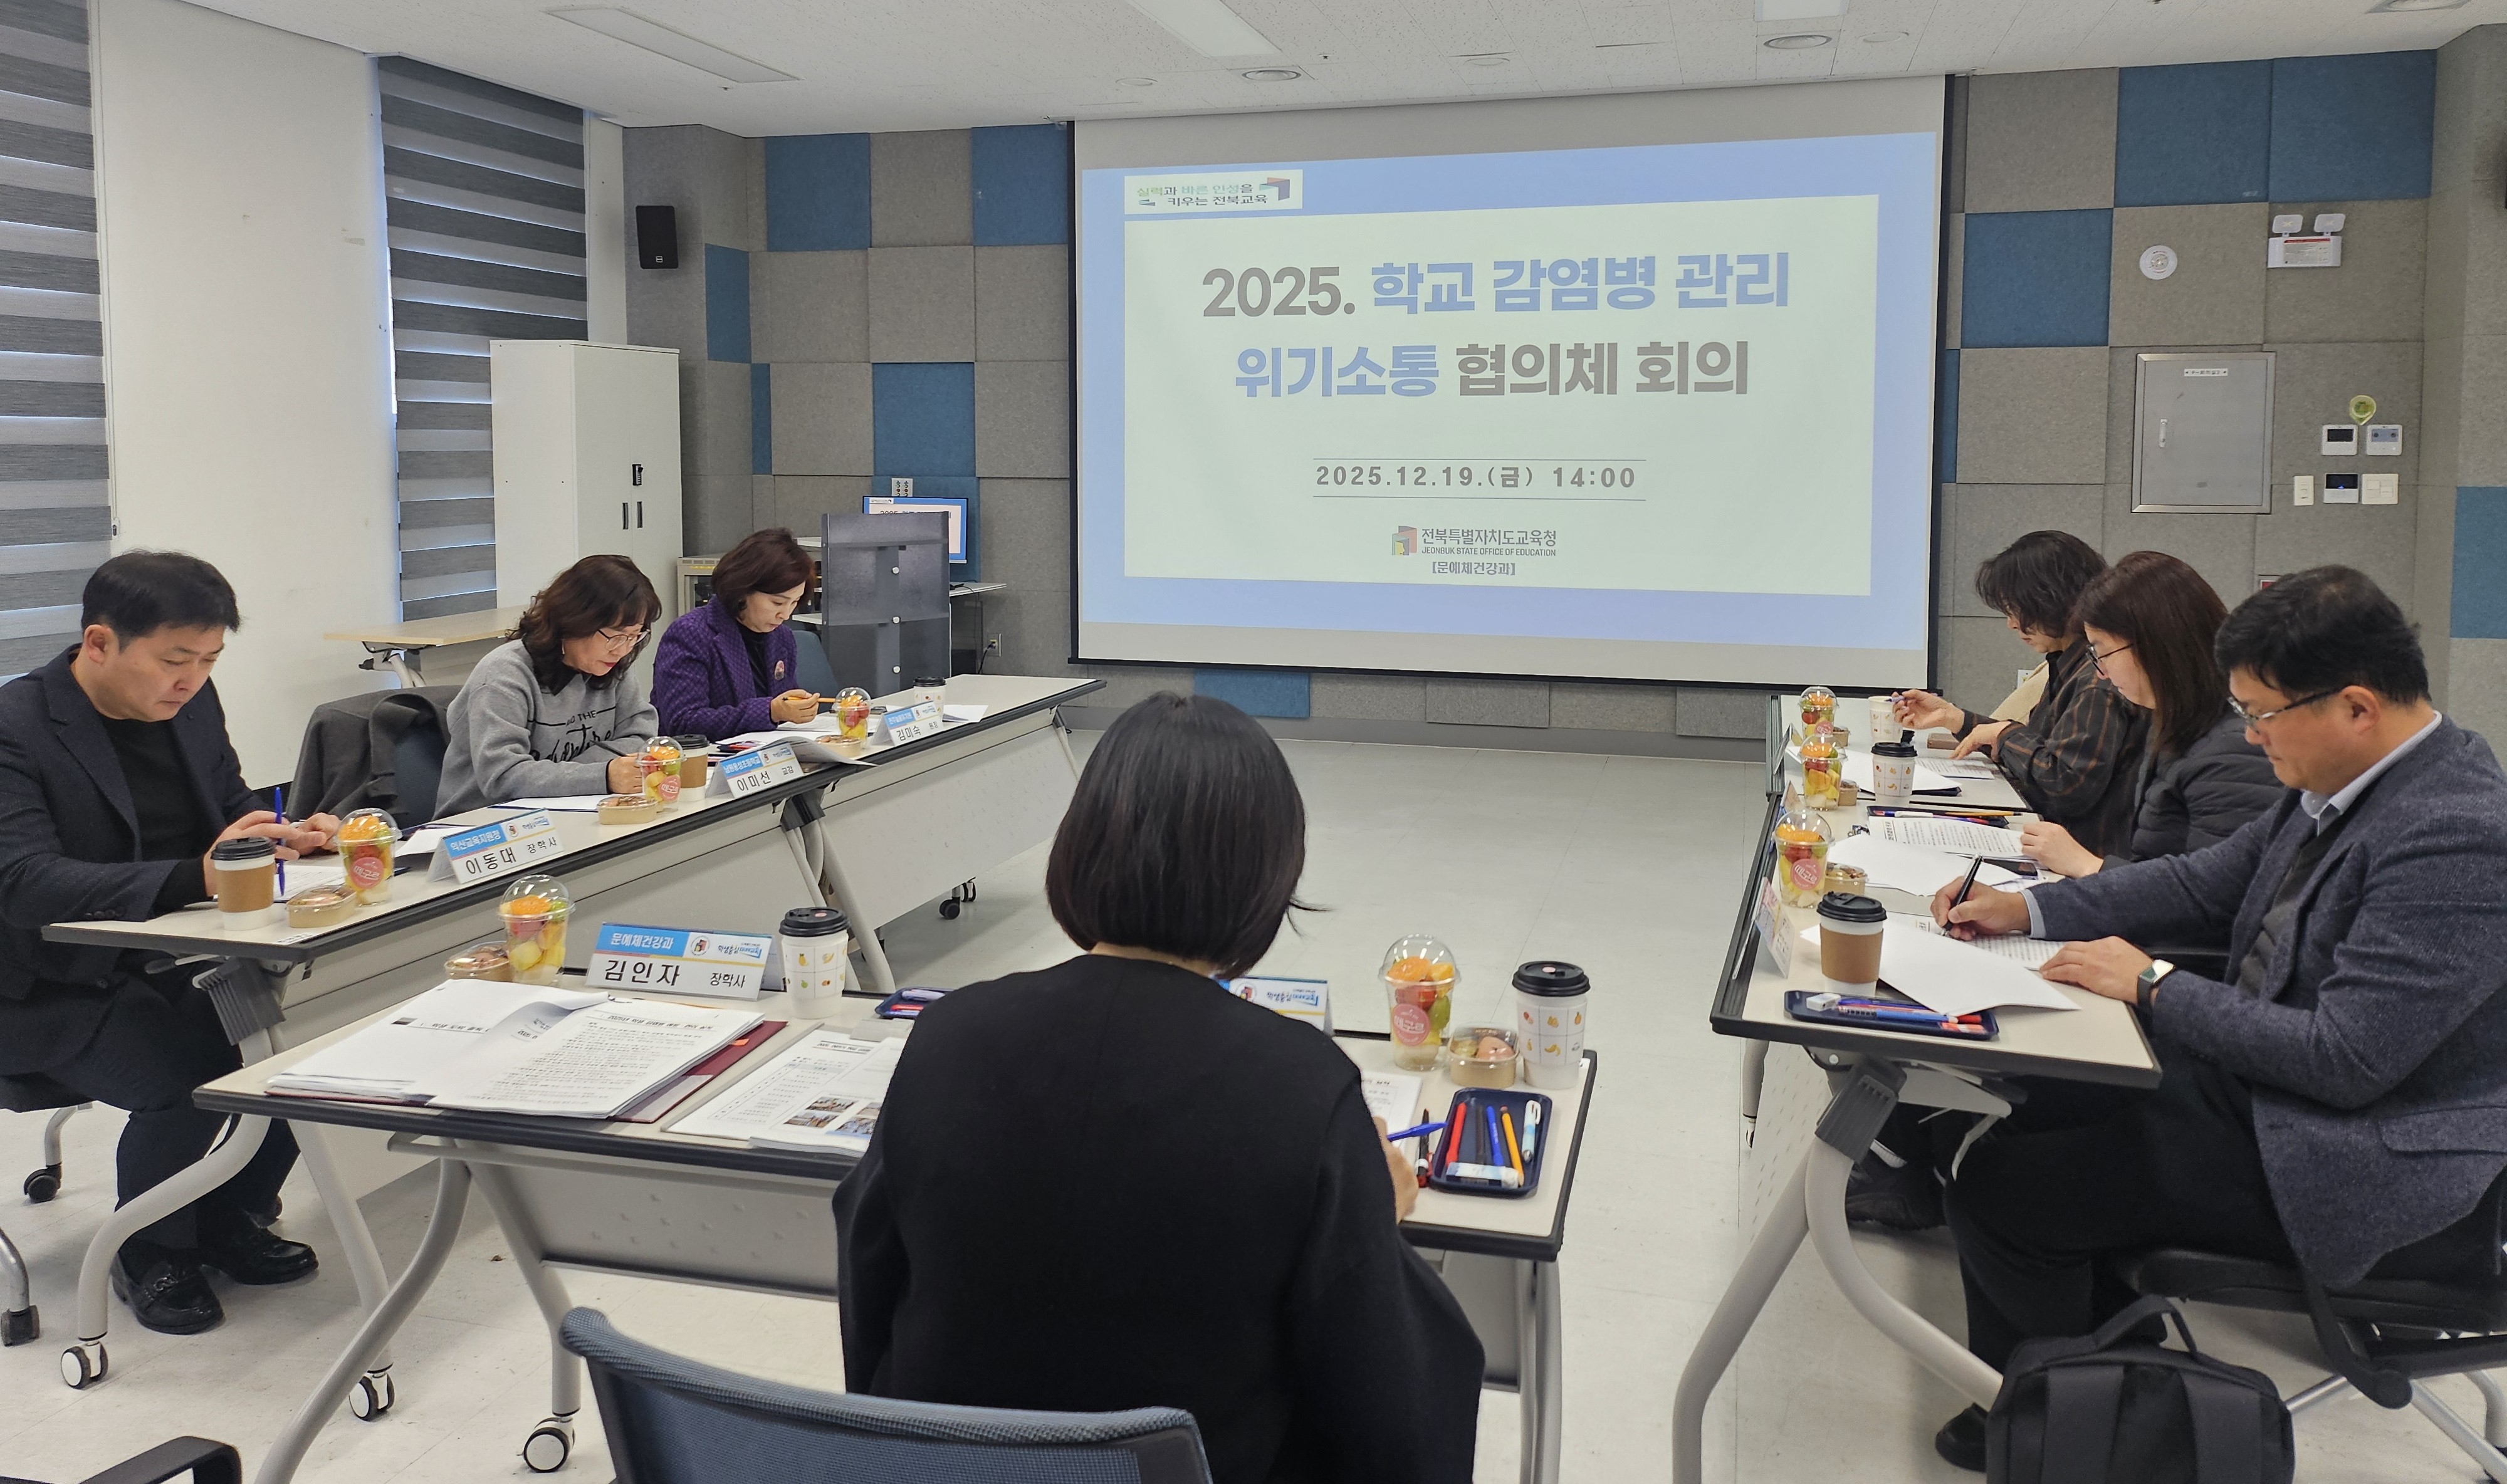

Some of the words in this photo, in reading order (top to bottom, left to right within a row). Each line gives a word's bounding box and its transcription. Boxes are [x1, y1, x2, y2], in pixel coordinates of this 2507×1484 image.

[1181, 185, 1208, 196] 바른
[1213, 183, 1254, 195] 인성을
[1168, 196, 1208, 207] 키우는
[1213, 194, 1268, 206] 전북교육
[1201, 266, 1356, 317] 2025.
[1371, 261, 1475, 315] 학교
[1493, 256, 1657, 311] 감염병
[1675, 251, 1789, 308] 관리
[1235, 344, 1440, 398] 위기소통
[1455, 341, 1618, 396] 협의체
[1635, 340, 1748, 395] 회의
[1316, 465, 1534, 489] 2025.12.19.(금)
[1552, 467, 1636, 488] 14:00
[1421, 528, 1557, 547] 전북특별자치도교육청
[1421, 546, 1455, 555] JEONBUK
[1456, 547, 1479, 555] STATE
[1480, 548, 1504, 556] OFFICE
[577, 710, 597, 721] THE
[896, 725, 921, 741] 김미숙
[736, 770, 772, 791] 이미선
[781, 765, 794, 775] 교감
[449, 829, 501, 852] 익산교육지원청
[465, 847, 516, 875] 이동대
[526, 836, 557, 854] 장학사
[610, 932, 674, 950] 문예체건강과
[604, 959, 681, 986] 김인자
[709, 972, 746, 989] 장학사
